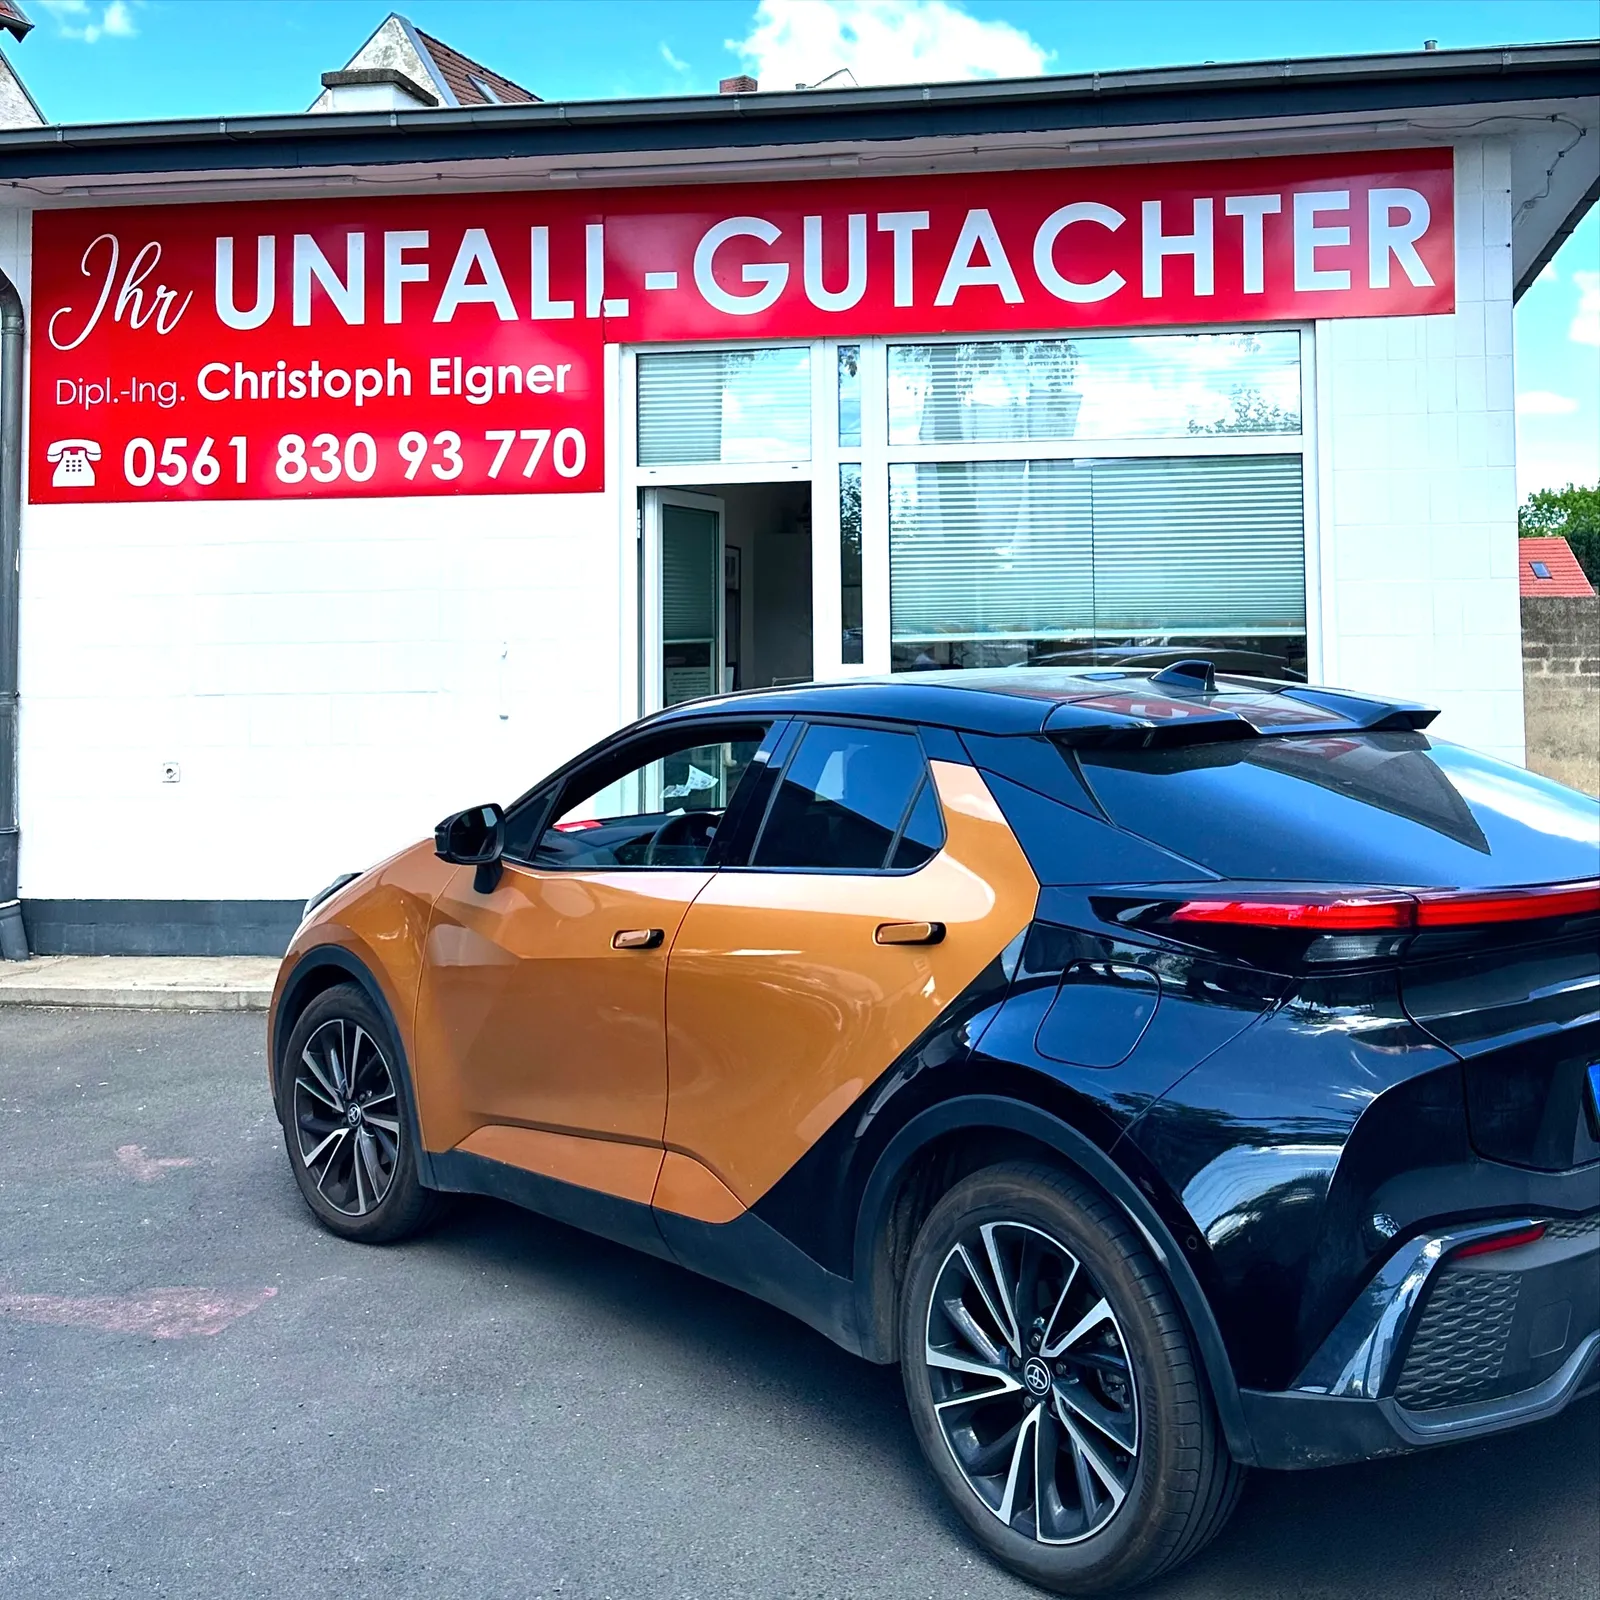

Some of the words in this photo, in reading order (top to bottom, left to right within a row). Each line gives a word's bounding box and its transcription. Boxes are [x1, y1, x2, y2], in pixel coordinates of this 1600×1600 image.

[49, 234, 193, 350] Ihr
[56, 377, 186, 411] Dipl.-Ing.
[198, 359, 411, 407] Christoph
[430, 357, 572, 405] Elgner
[124, 437, 247, 486] 0561
[275, 433, 377, 483] 830
[398, 431, 463, 480] 93
[486, 428, 586, 478] 770
